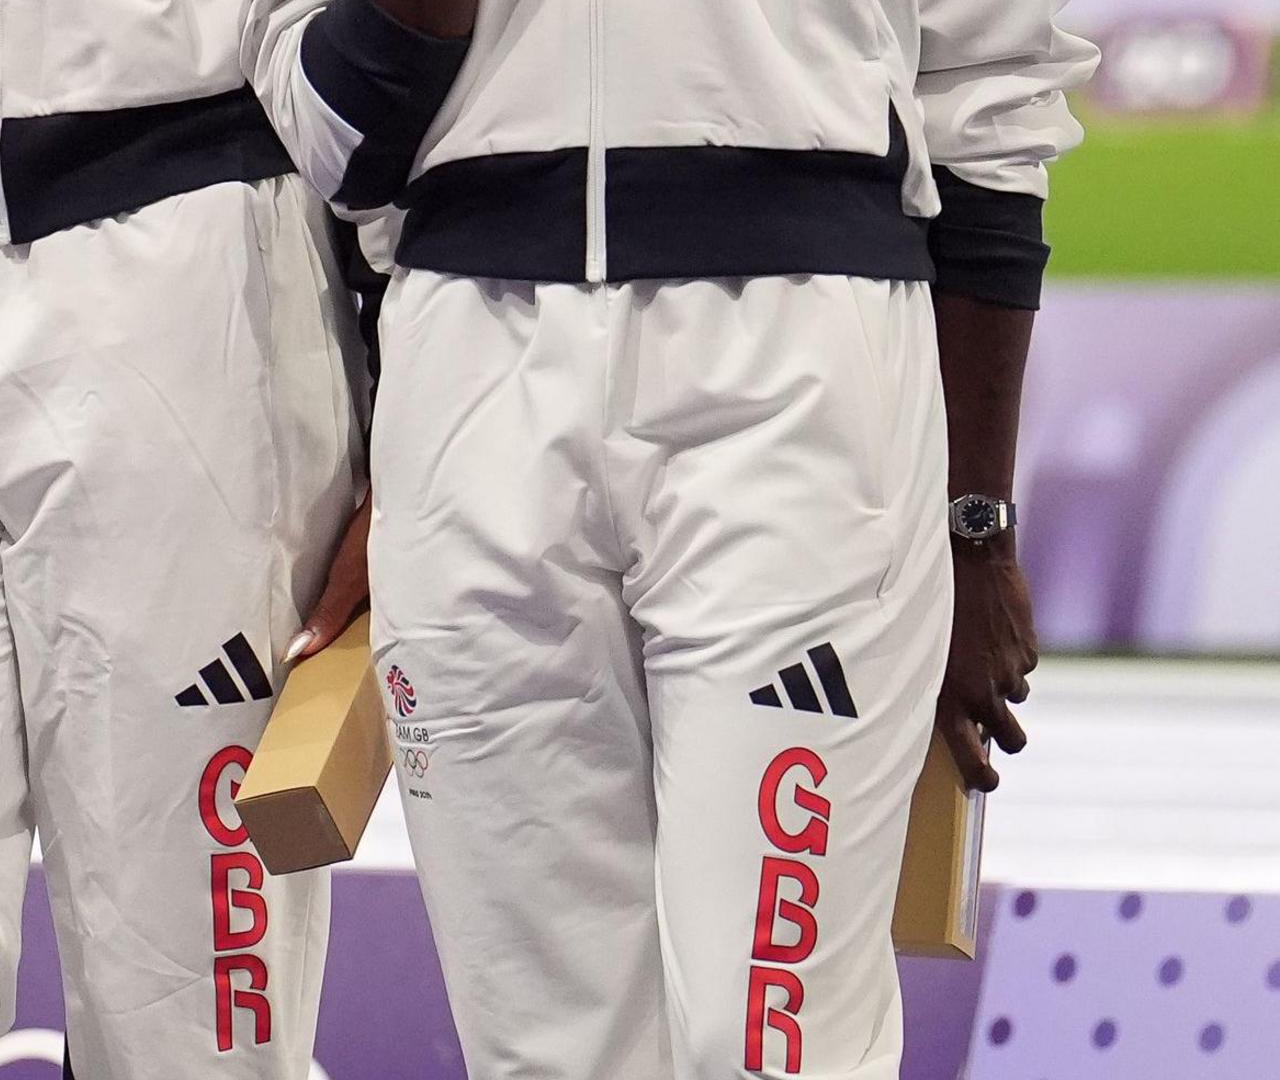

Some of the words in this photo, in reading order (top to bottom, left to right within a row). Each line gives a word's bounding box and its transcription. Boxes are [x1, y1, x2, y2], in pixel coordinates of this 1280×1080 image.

[413, 727, 430, 742] GB
[198, 744, 271, 1053] GBR
[743, 746, 832, 1074] GBR
